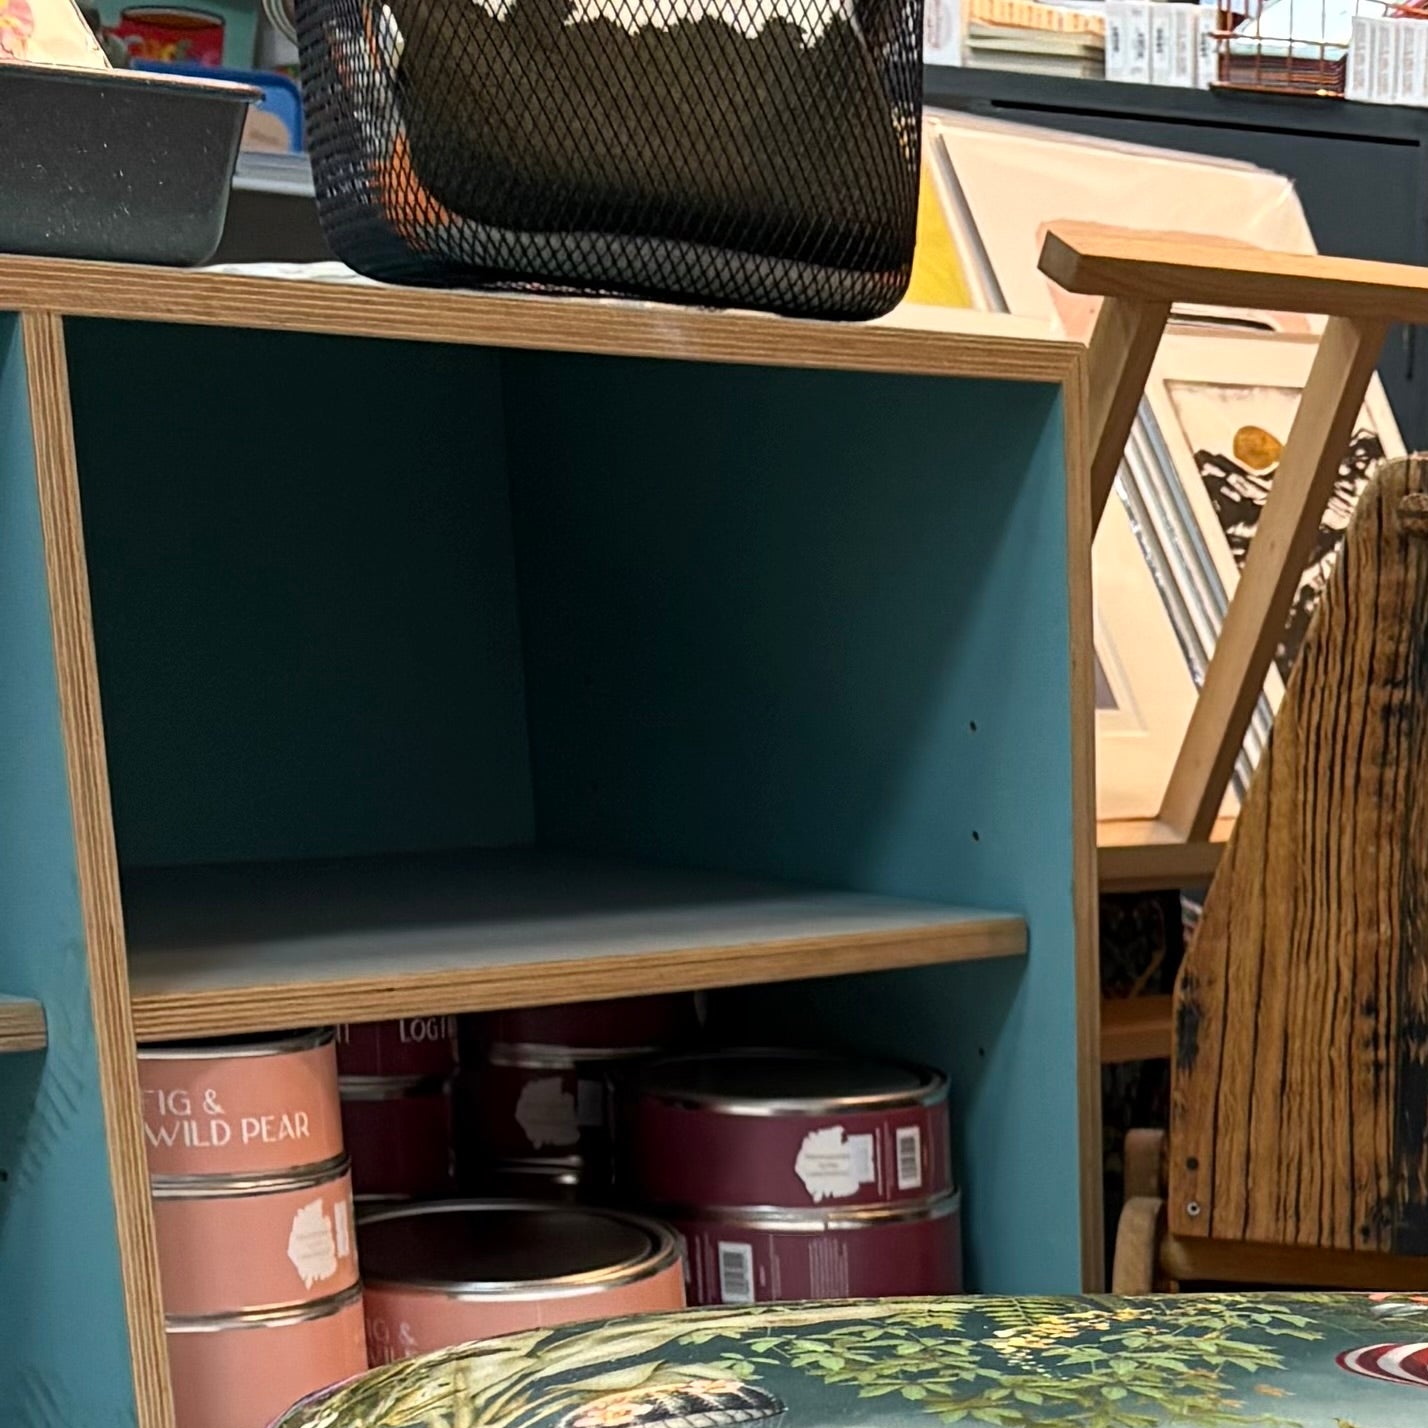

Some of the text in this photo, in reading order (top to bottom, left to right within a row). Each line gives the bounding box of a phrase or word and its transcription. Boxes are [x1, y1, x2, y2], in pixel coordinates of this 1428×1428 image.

[203, 1088, 225, 1115] &
[143, 1111, 310, 1148] WILD PEAR
